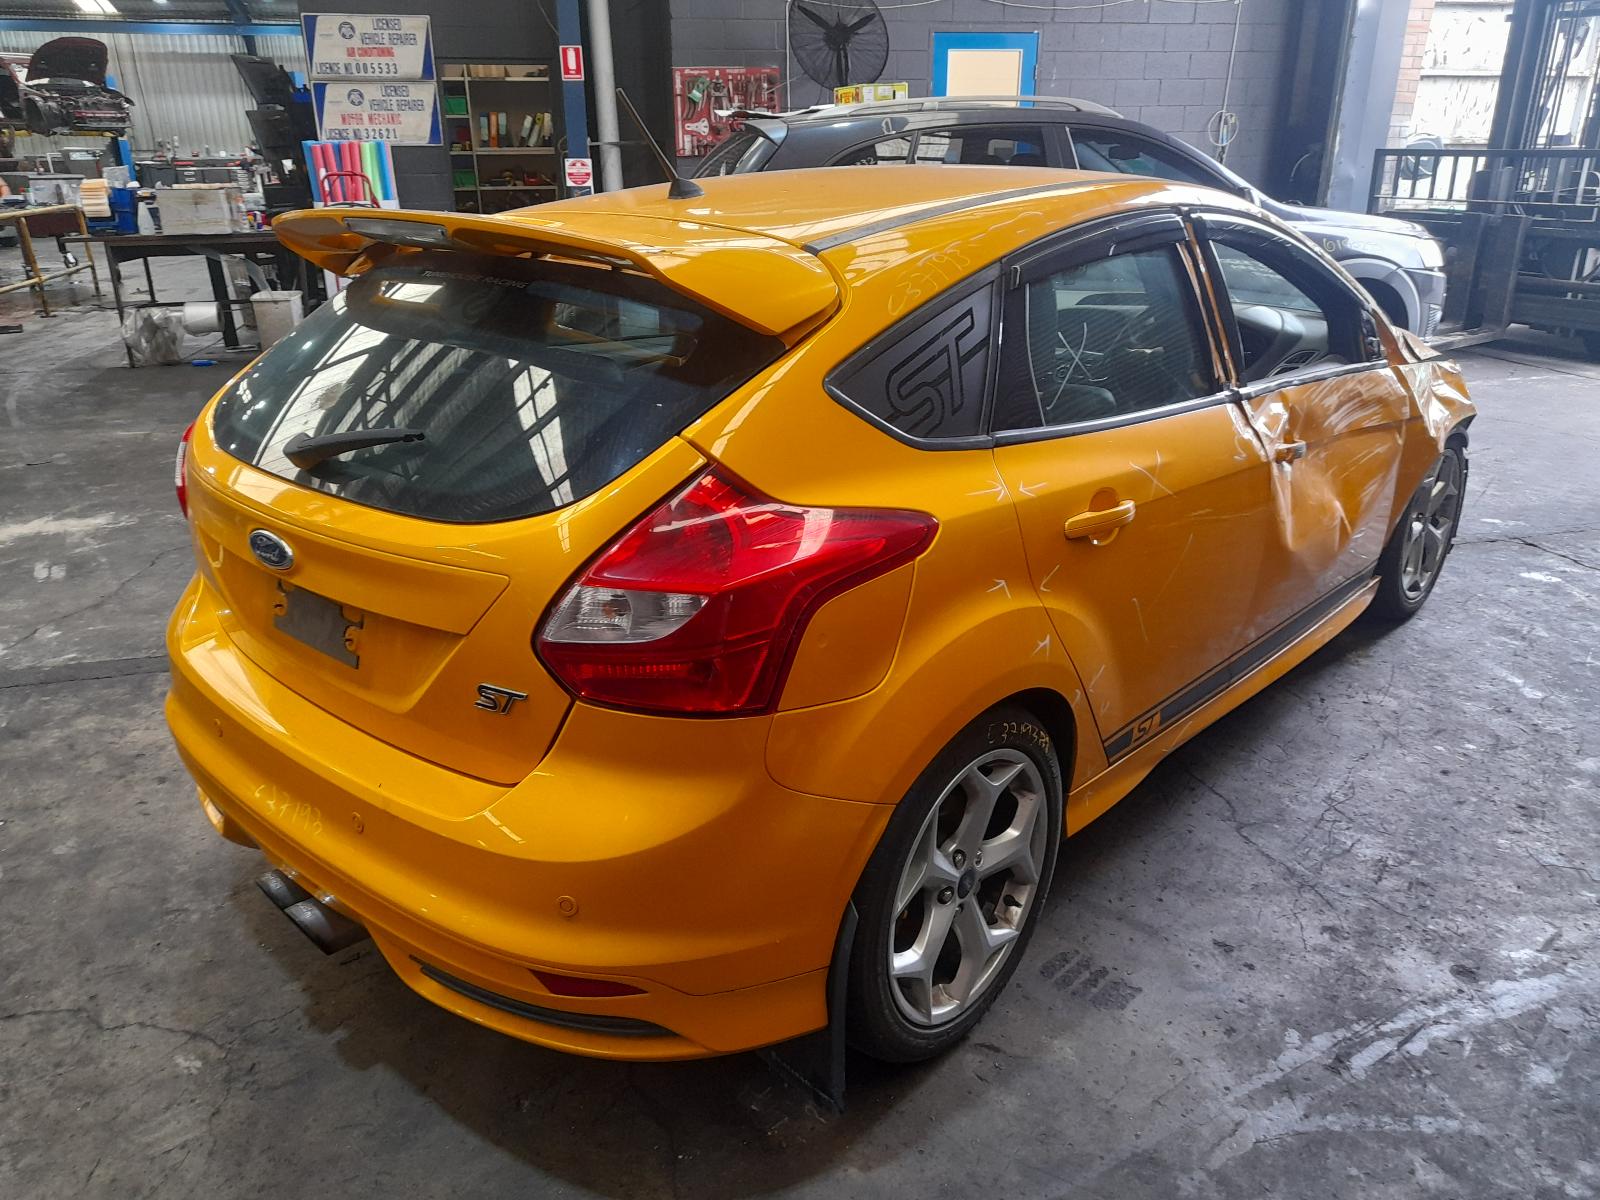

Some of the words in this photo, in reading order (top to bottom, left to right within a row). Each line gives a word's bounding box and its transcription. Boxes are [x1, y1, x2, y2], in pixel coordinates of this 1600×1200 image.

[361, 32, 387, 46] VEHICLE
[388, 32, 418, 46] REPAIRER
[355, 62, 398, 75] 005533
[368, 98, 395, 112] VEHICLE
[396, 98, 425, 112] REPAIRER
[364, 128, 399, 140] 32621
[885, 306, 975, 438] ST
[473, 683, 529, 715] ST
[1133, 710, 1161, 742] ST
